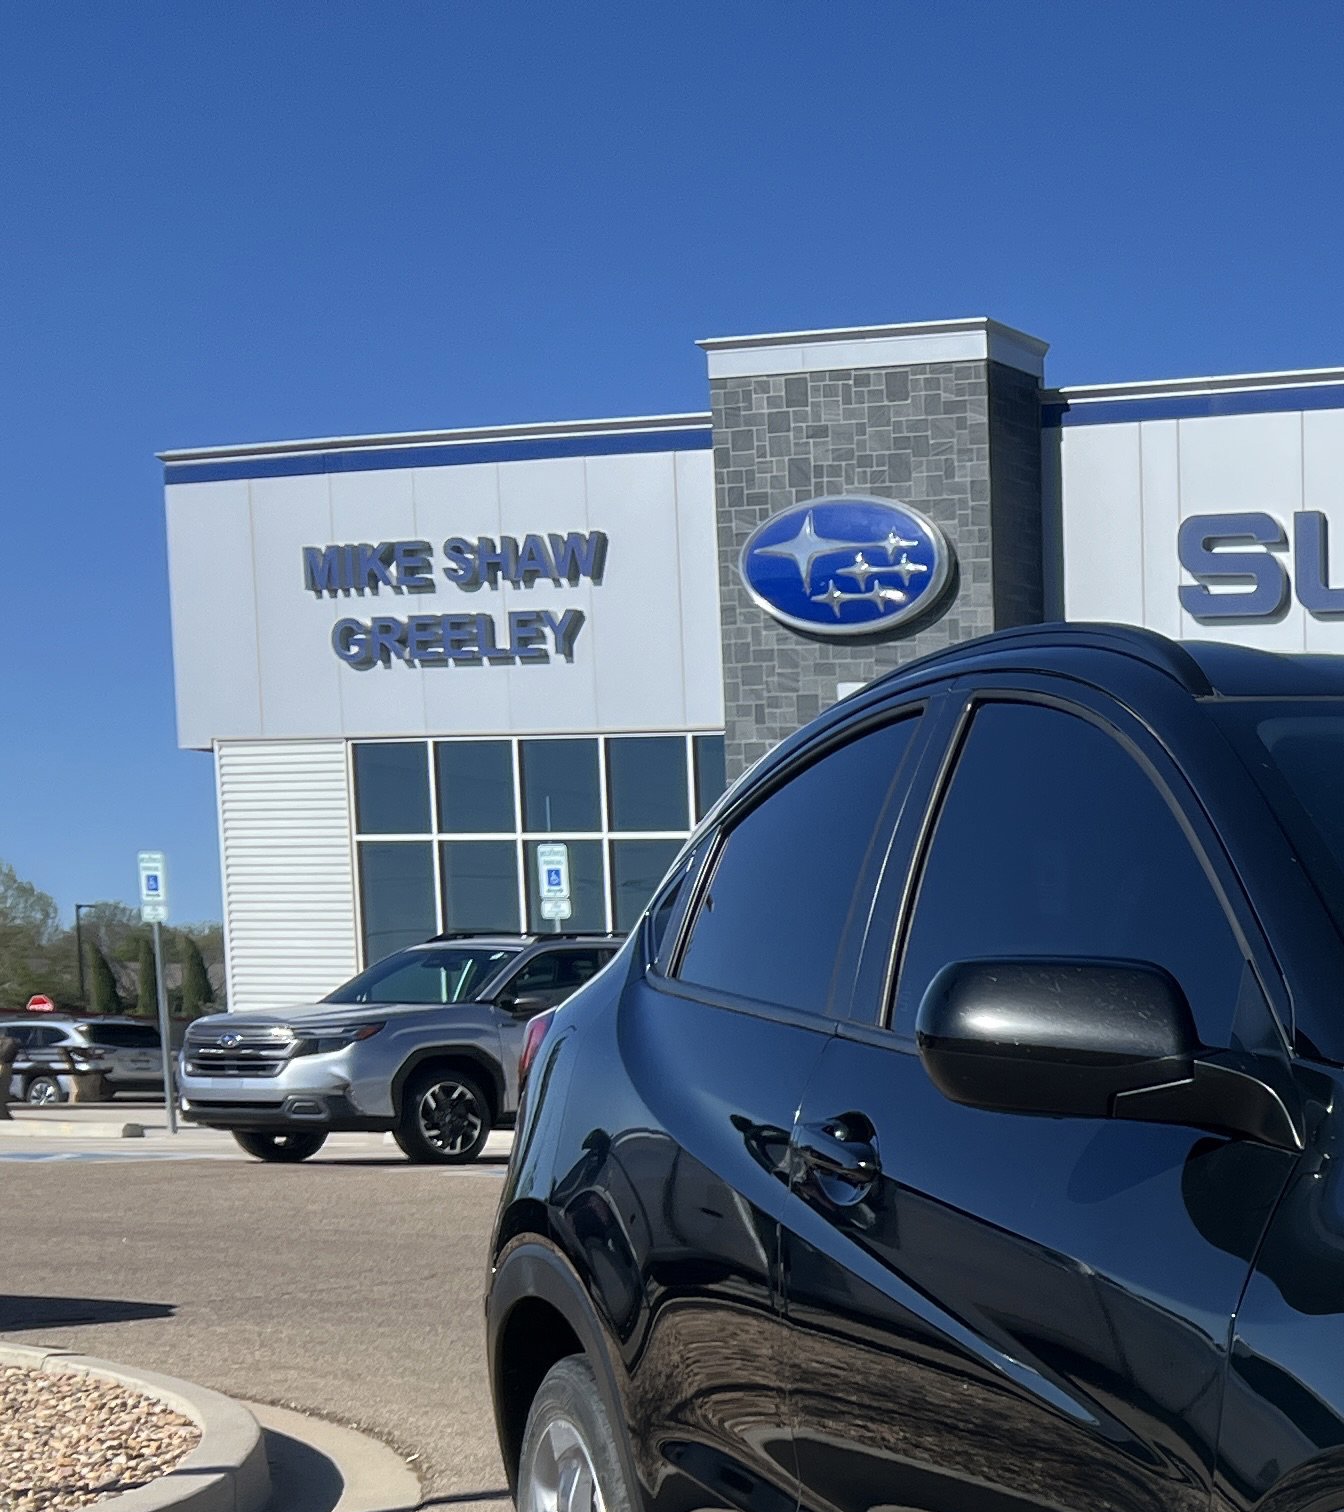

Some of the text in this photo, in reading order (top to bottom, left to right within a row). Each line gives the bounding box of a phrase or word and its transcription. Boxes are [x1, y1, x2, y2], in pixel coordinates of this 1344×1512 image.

[302, 531, 608, 597] MIKE SHAW
[332, 608, 586, 671] GREELEY
